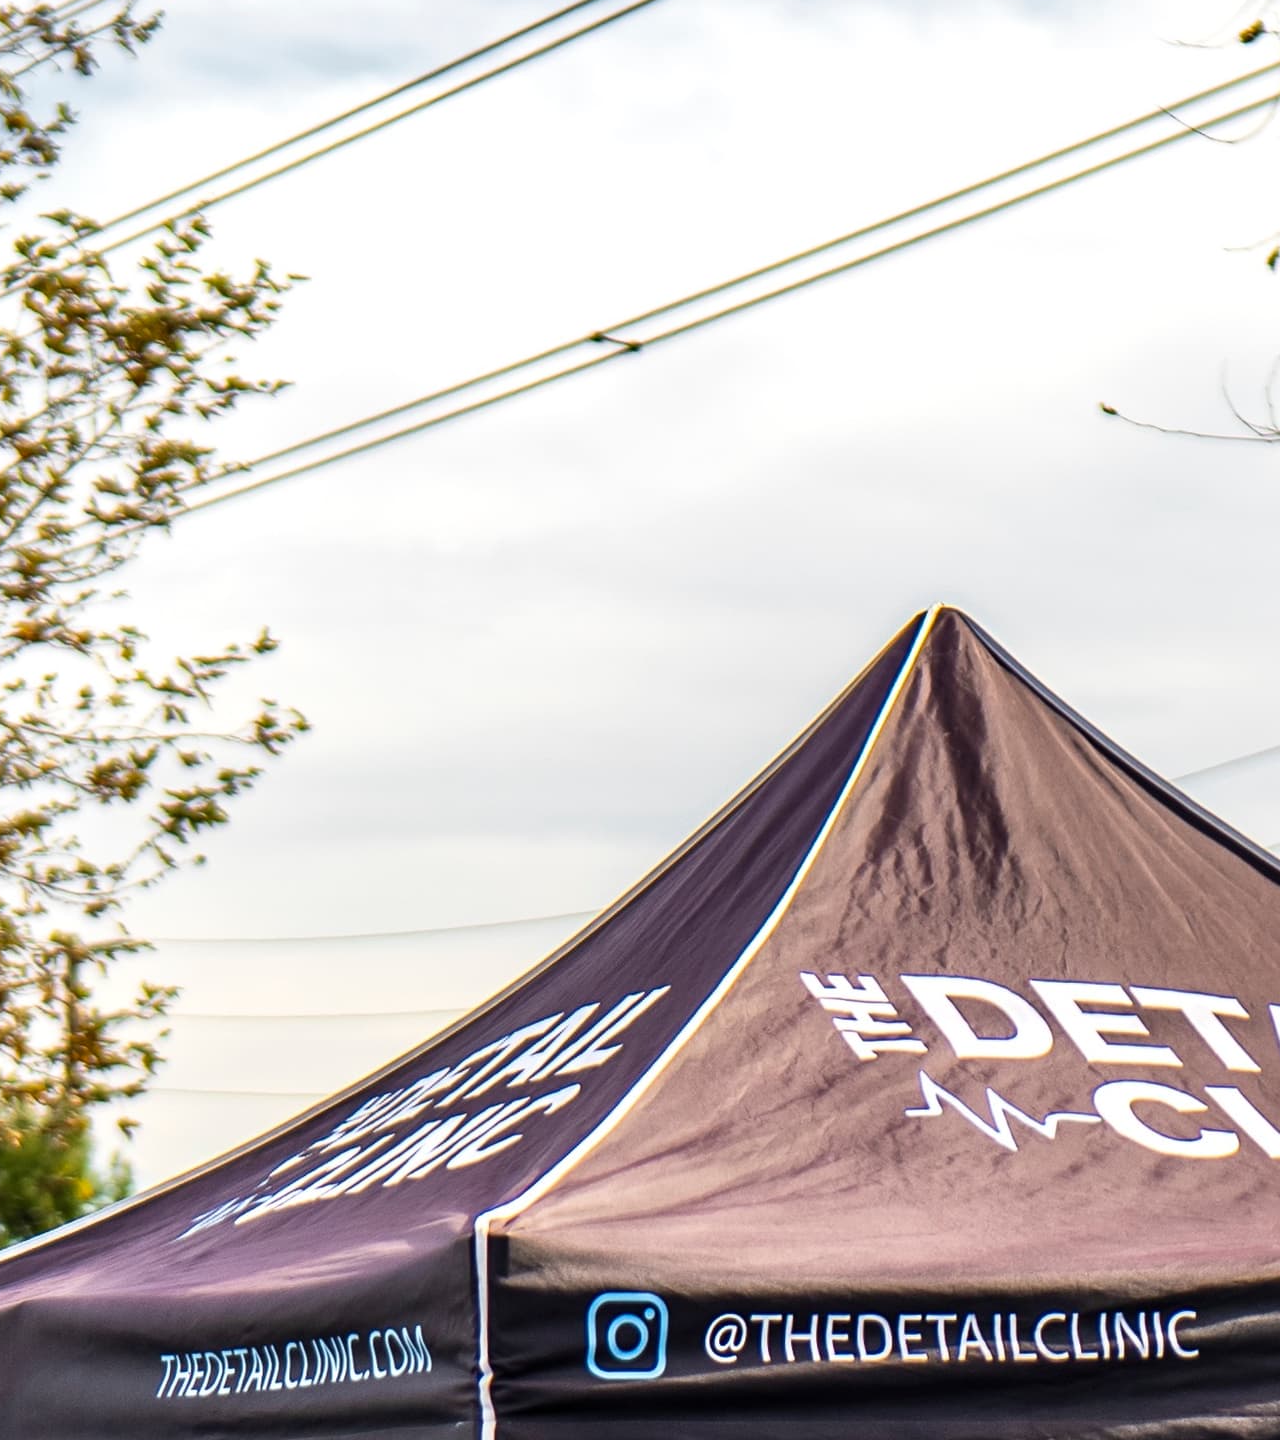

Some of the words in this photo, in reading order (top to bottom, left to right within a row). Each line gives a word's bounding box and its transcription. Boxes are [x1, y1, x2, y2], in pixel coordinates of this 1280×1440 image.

[799, 972, 928, 1060] THE
[234, 1082, 582, 1225] CLINIC
[156, 1324, 433, 1400] THEDETAILCLINIC.COM
[704, 1310, 1201, 1364] @THEDETAILCLINIC
